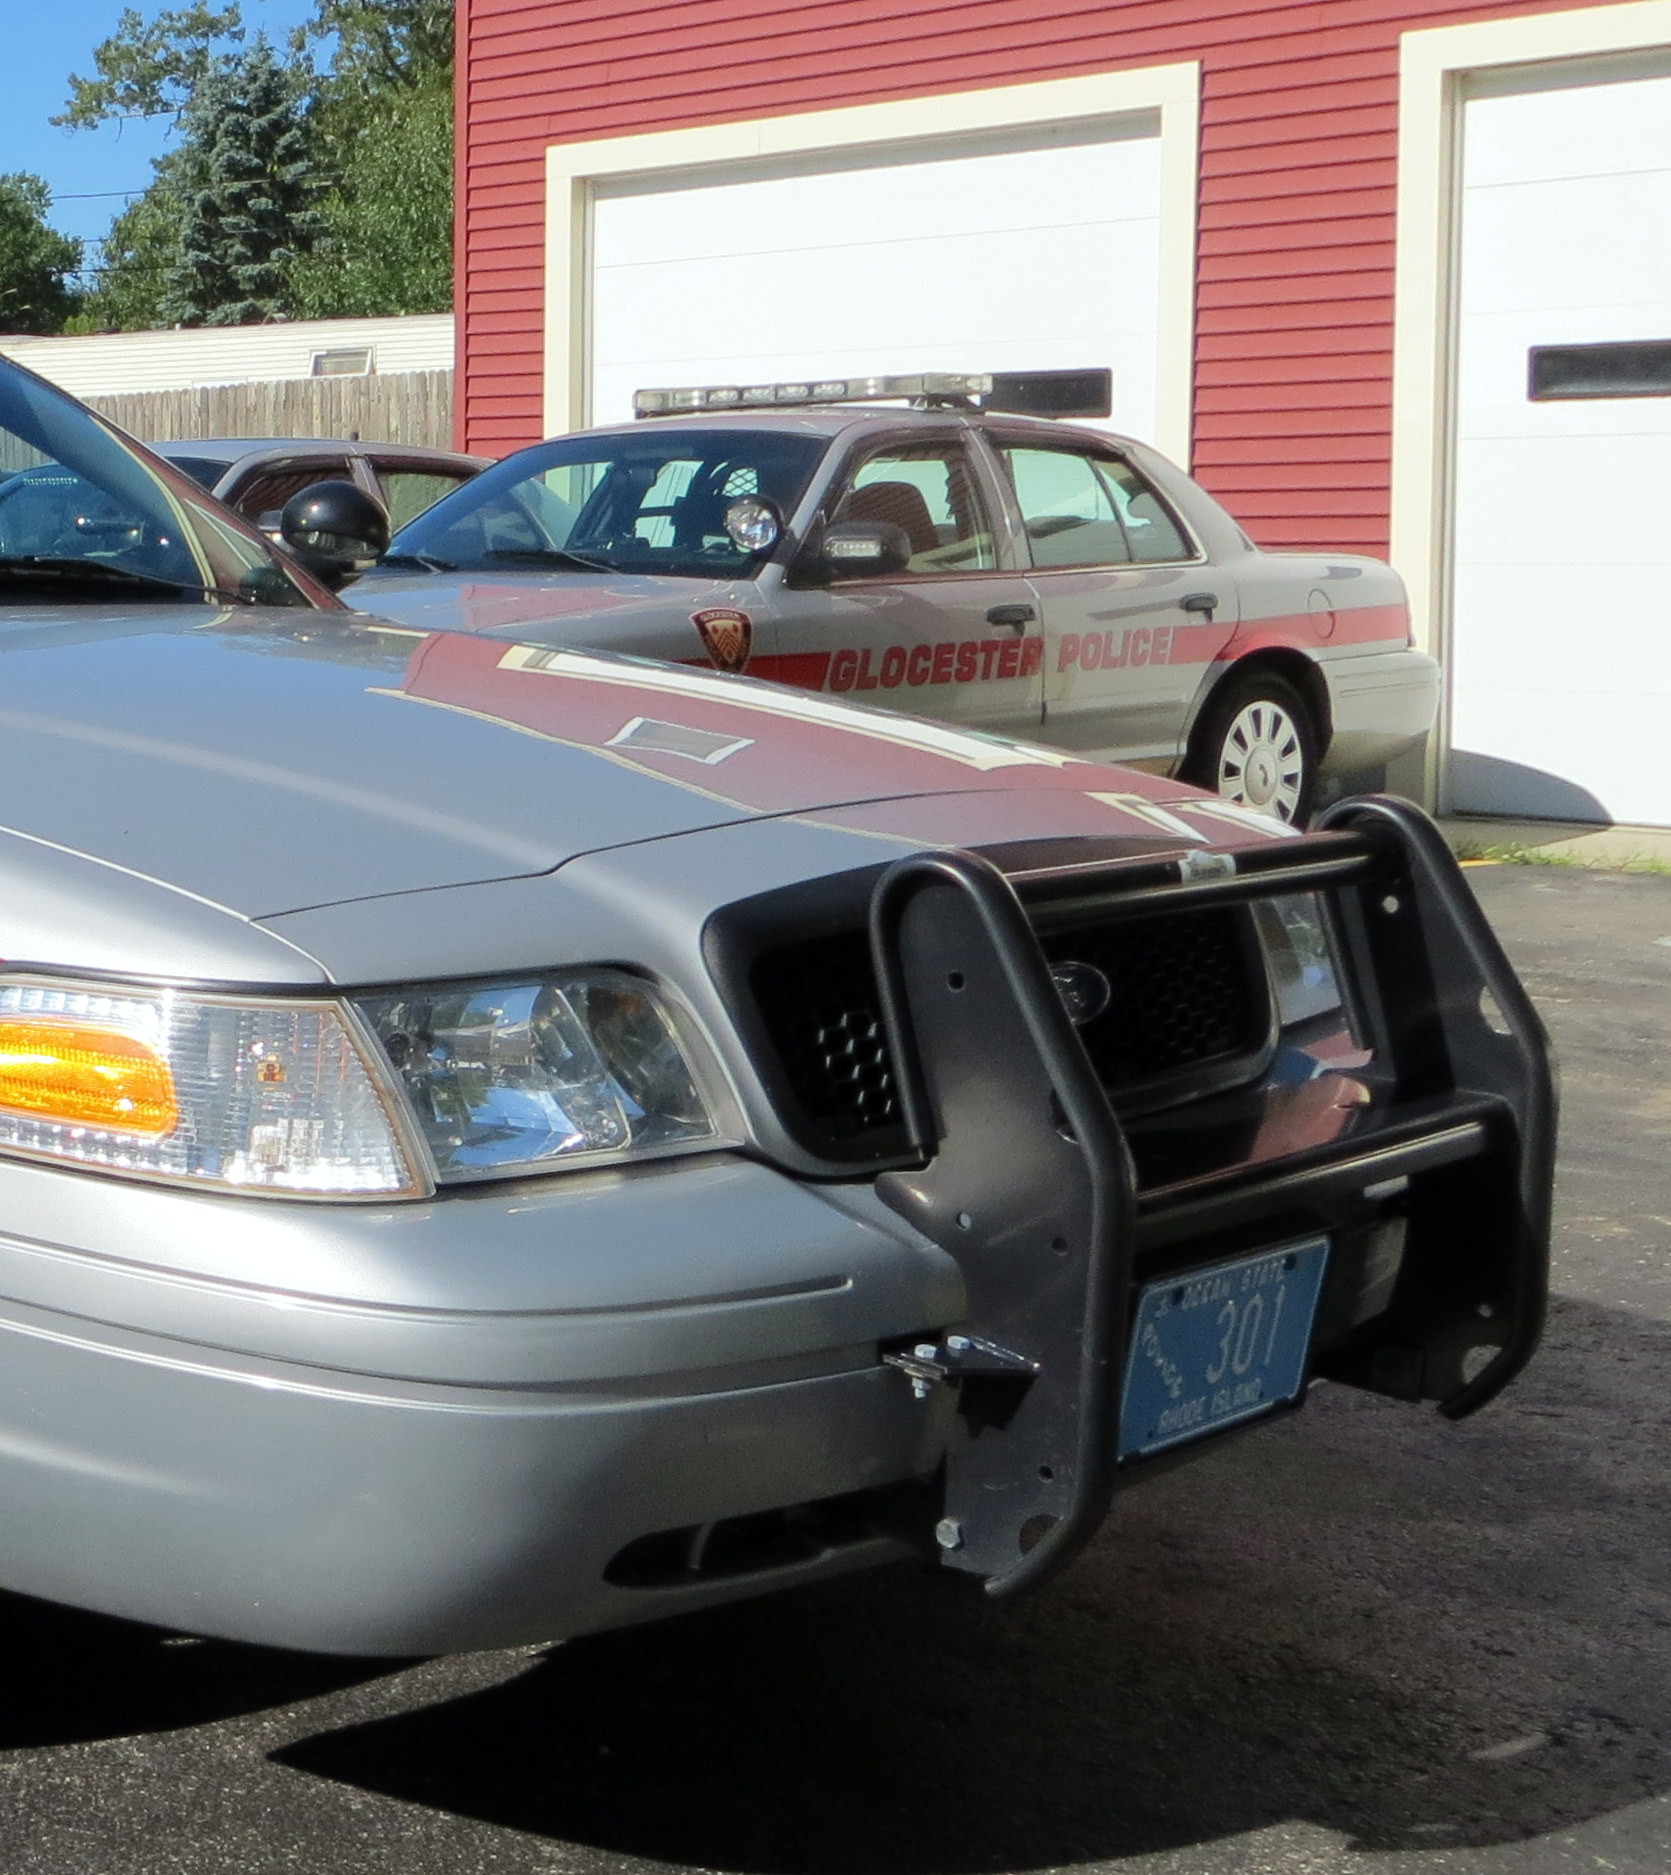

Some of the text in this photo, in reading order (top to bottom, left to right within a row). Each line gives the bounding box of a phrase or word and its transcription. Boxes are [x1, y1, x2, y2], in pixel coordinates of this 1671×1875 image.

[828, 627, 1171, 692] GLOCESTER POLICE
[1206, 1286, 1285, 1383] 301
[1159, 1378, 1261, 1434] RHODE ISLAND
